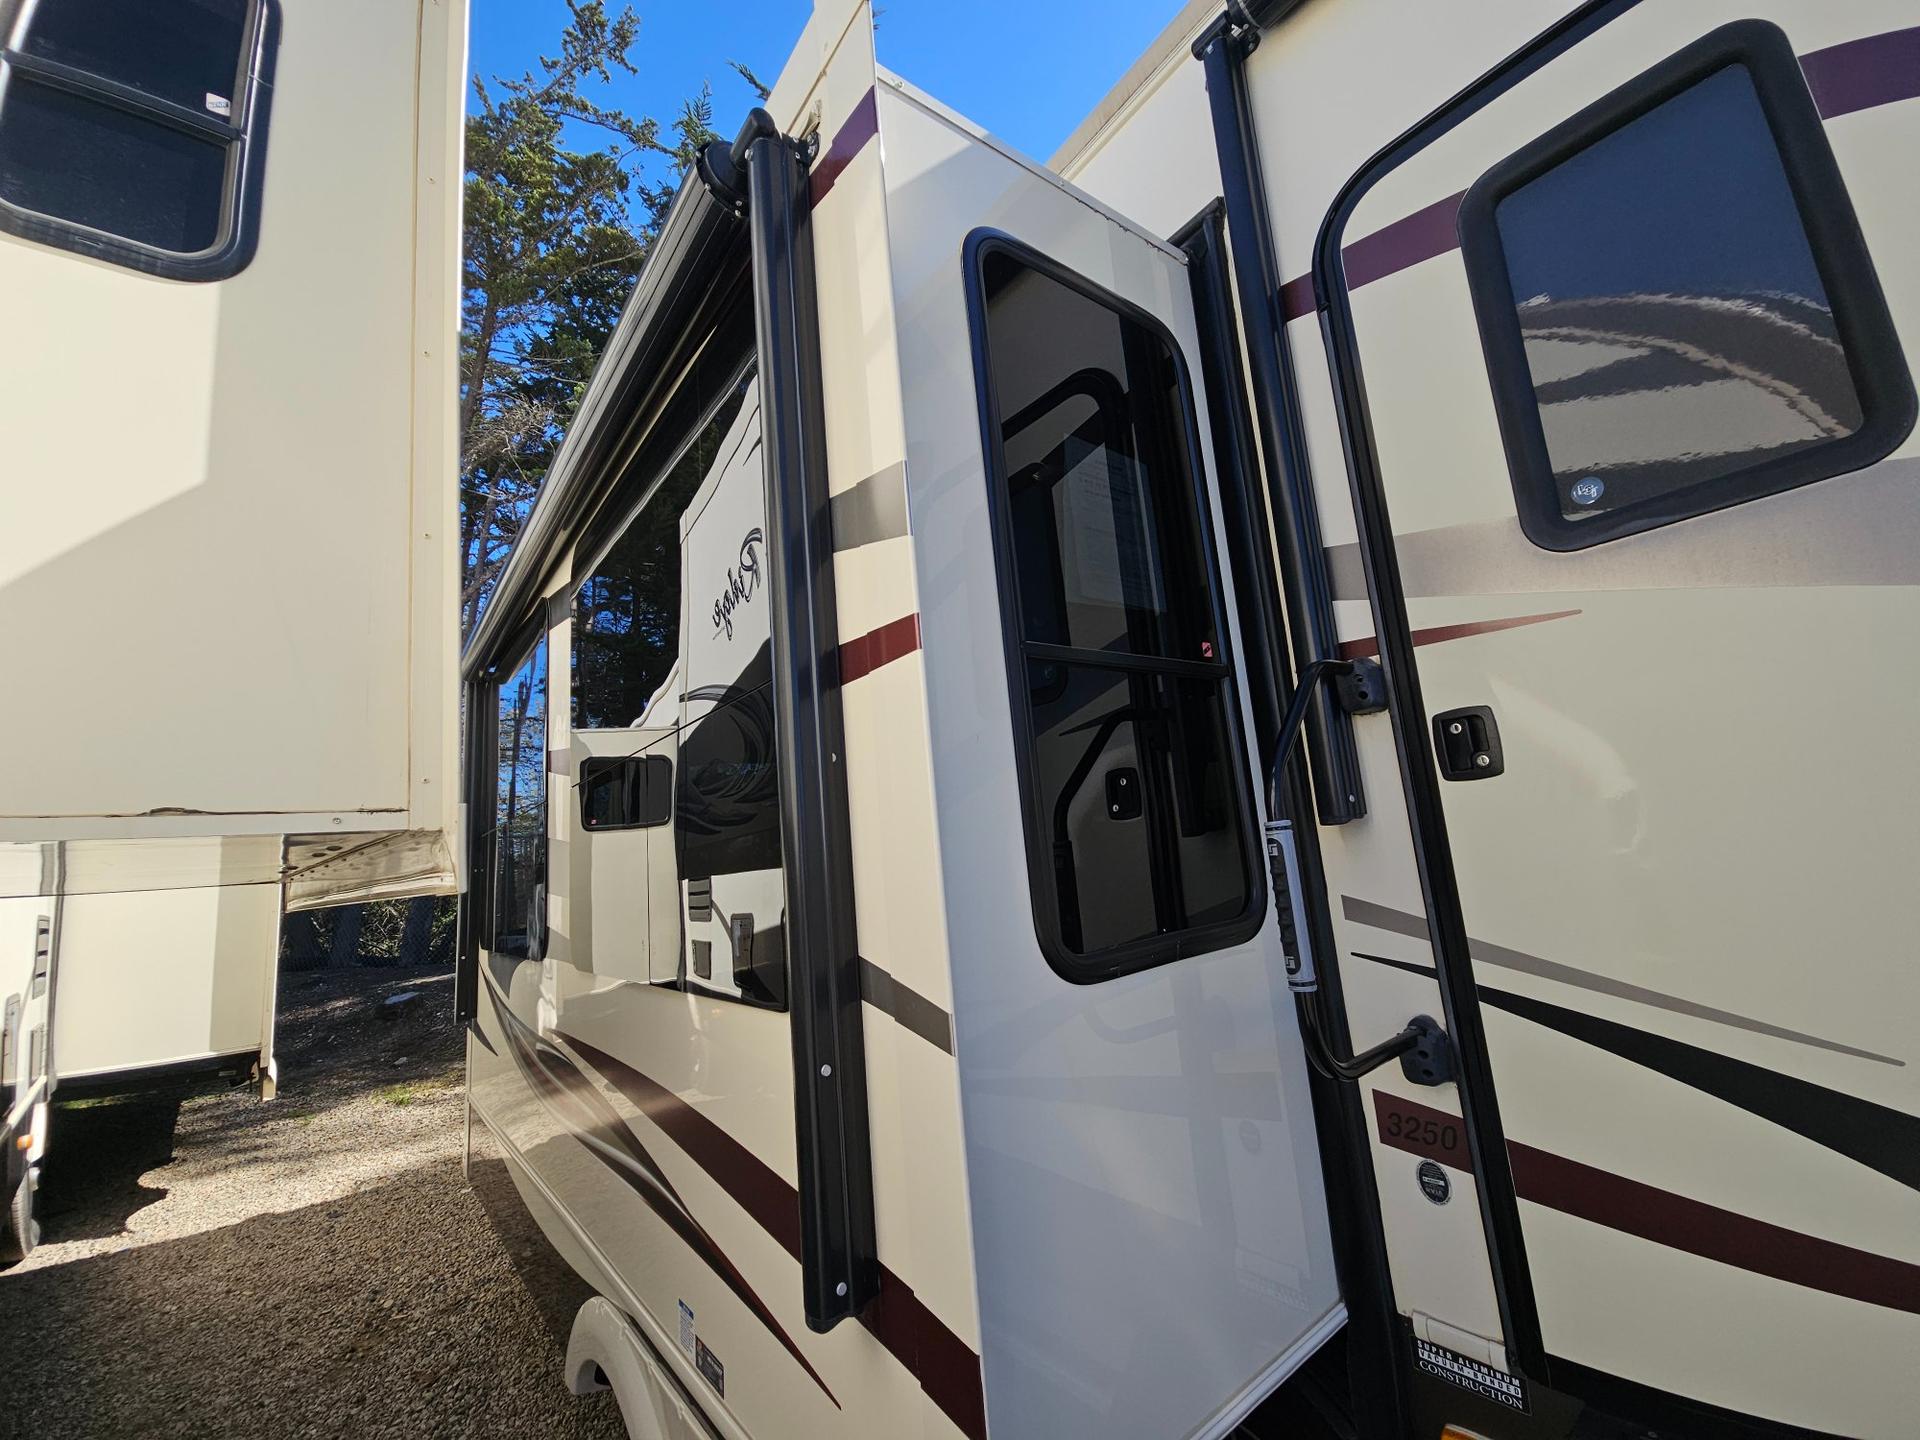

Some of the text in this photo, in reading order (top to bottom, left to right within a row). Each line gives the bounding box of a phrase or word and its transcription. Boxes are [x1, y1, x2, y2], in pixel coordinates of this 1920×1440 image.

[1387, 1111, 1458, 1151] 3250
[1417, 1340, 1520, 1387] SUPER ALUMINUM
[1420, 1360, 1523, 1409] CONSTRUCTION
